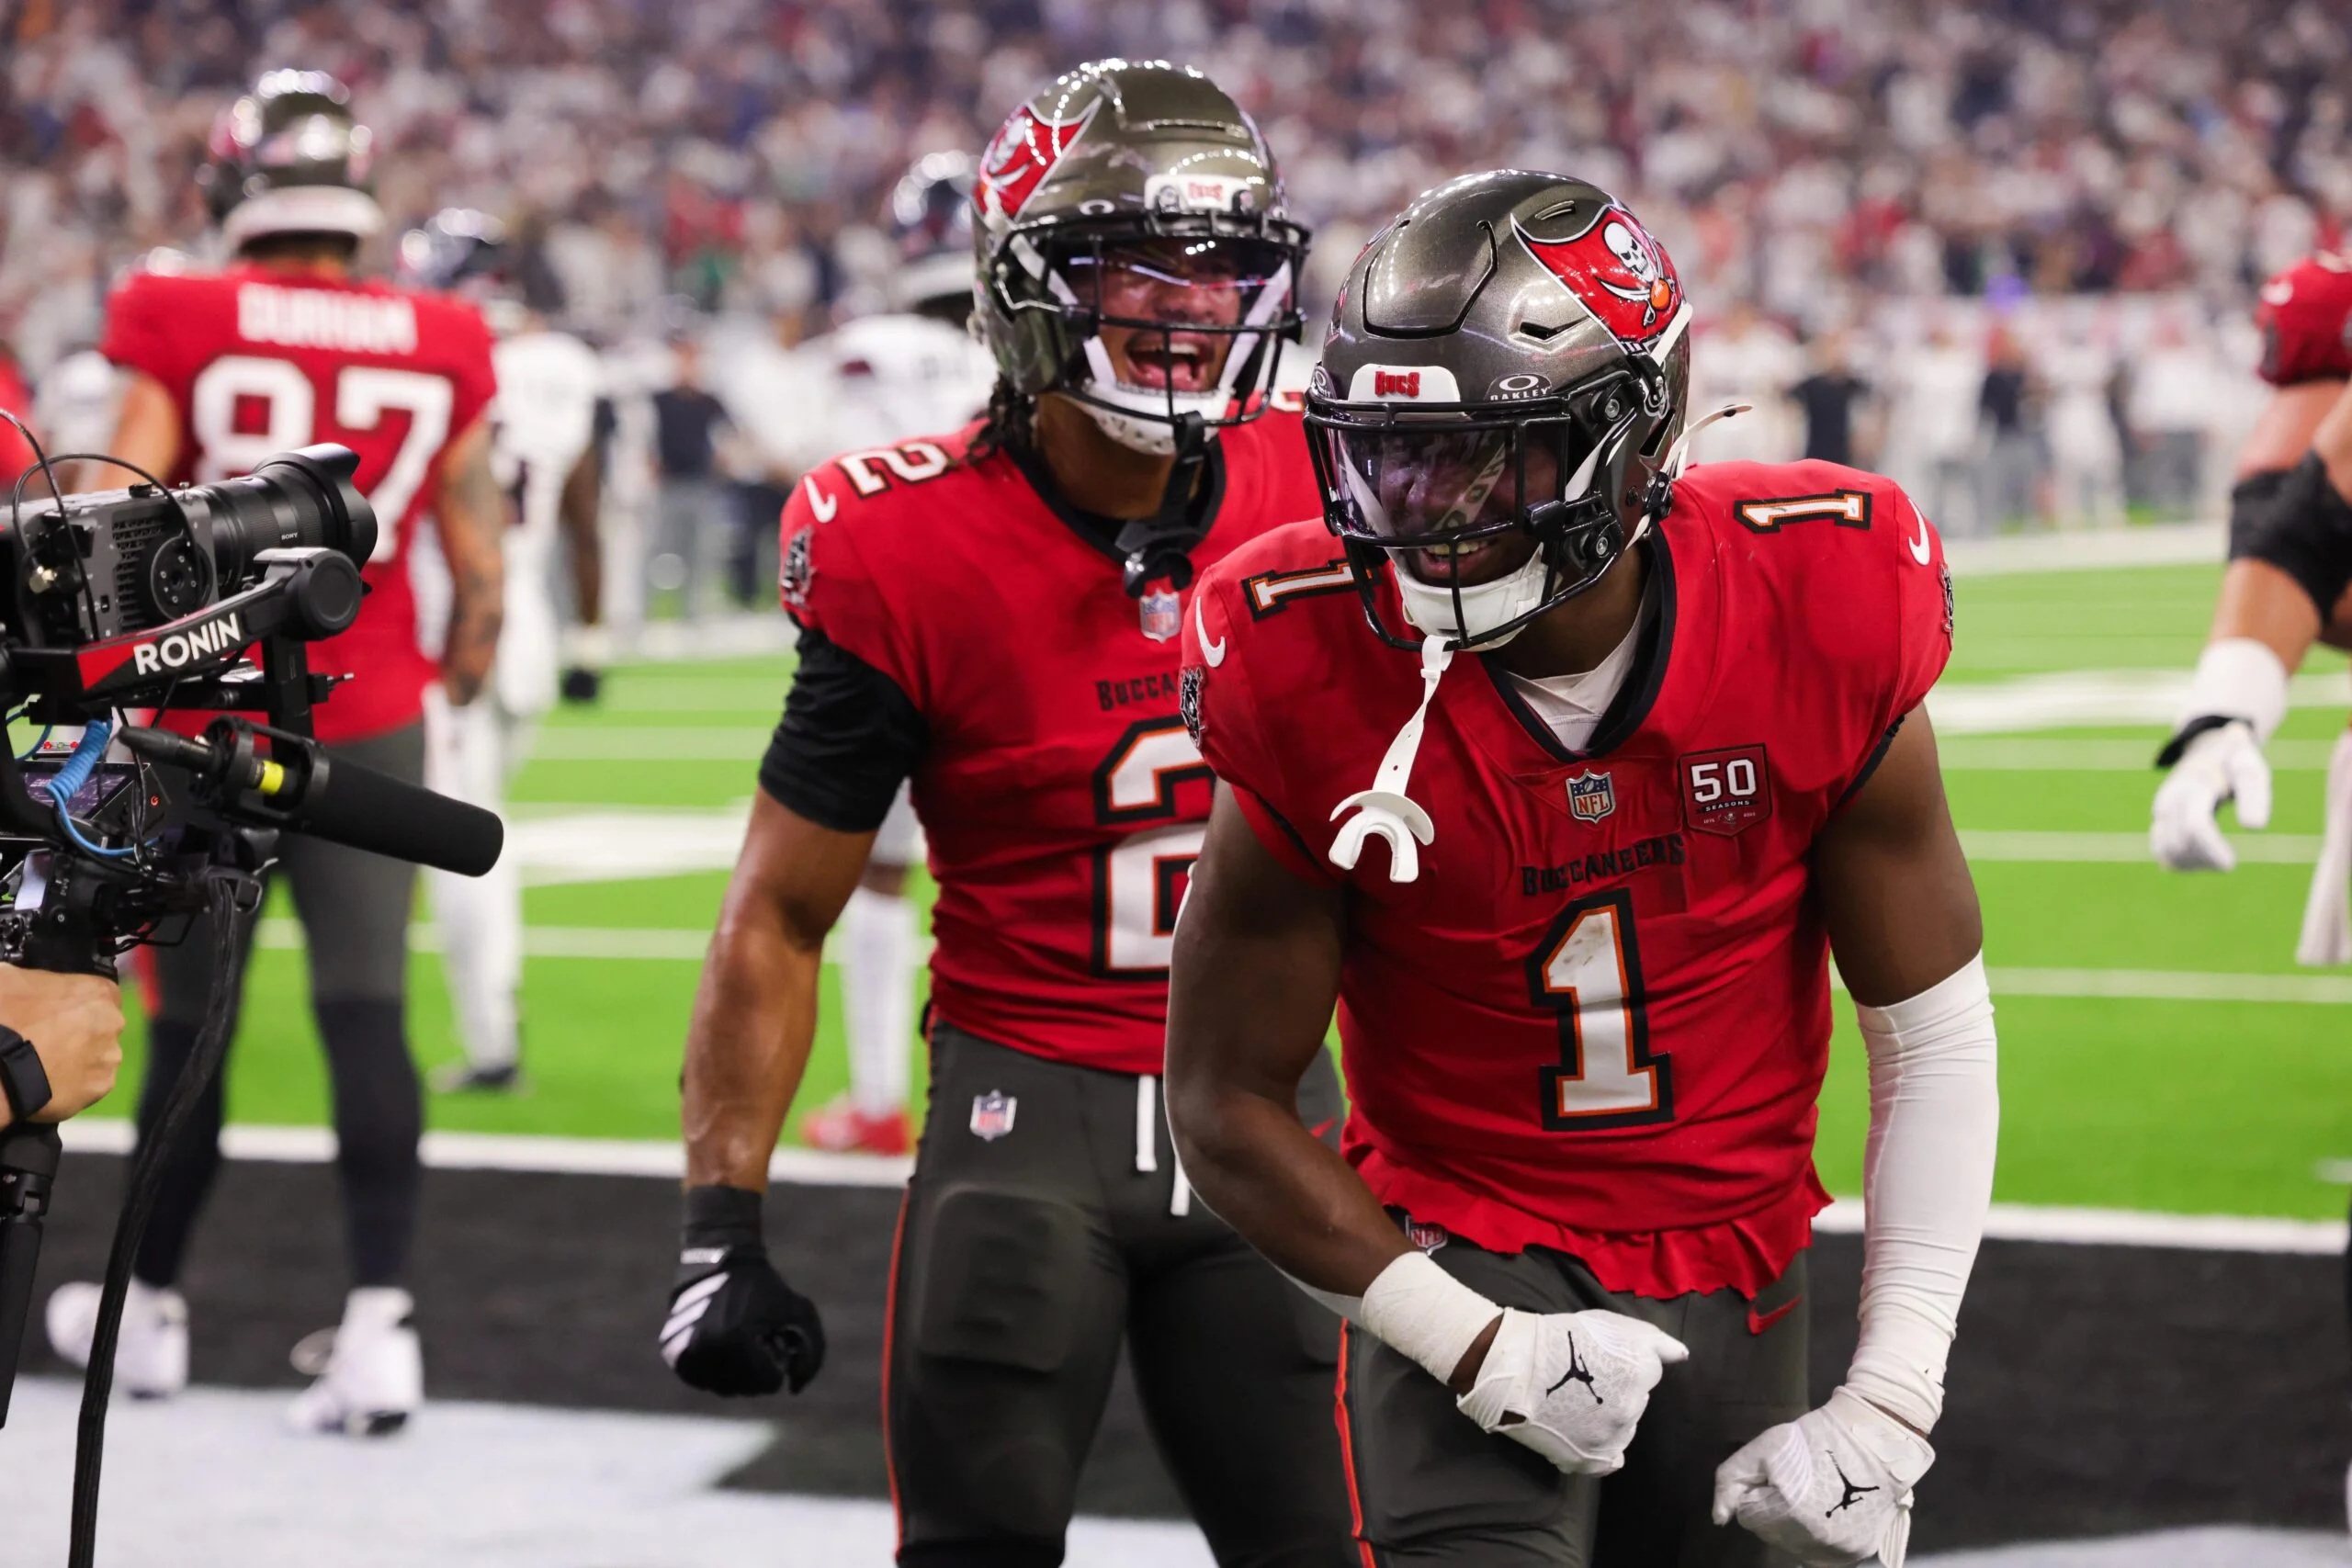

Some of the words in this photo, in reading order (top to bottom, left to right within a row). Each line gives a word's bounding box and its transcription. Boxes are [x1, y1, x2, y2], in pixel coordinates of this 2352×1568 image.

[1490, 386, 1550, 401] OAKLEY
[191, 354, 455, 563] 87
[836, 441, 953, 499] 2
[281, 532, 299, 540] SONY
[1734, 489, 1872, 535] 1
[1242, 558, 1385, 622] 1
[133, 612, 242, 676] RONIN
[1095, 671, 1179, 712] BUCCA
[1577, 794, 1608, 815] NFL
[1690, 758, 1757, 803] 50
[1705, 800, 1750, 812] SEASONS
[1092, 714, 1216, 979] 2
[1522, 834, 1686, 896] BUCCANEERS
[1527, 887, 1675, 1132] 1
